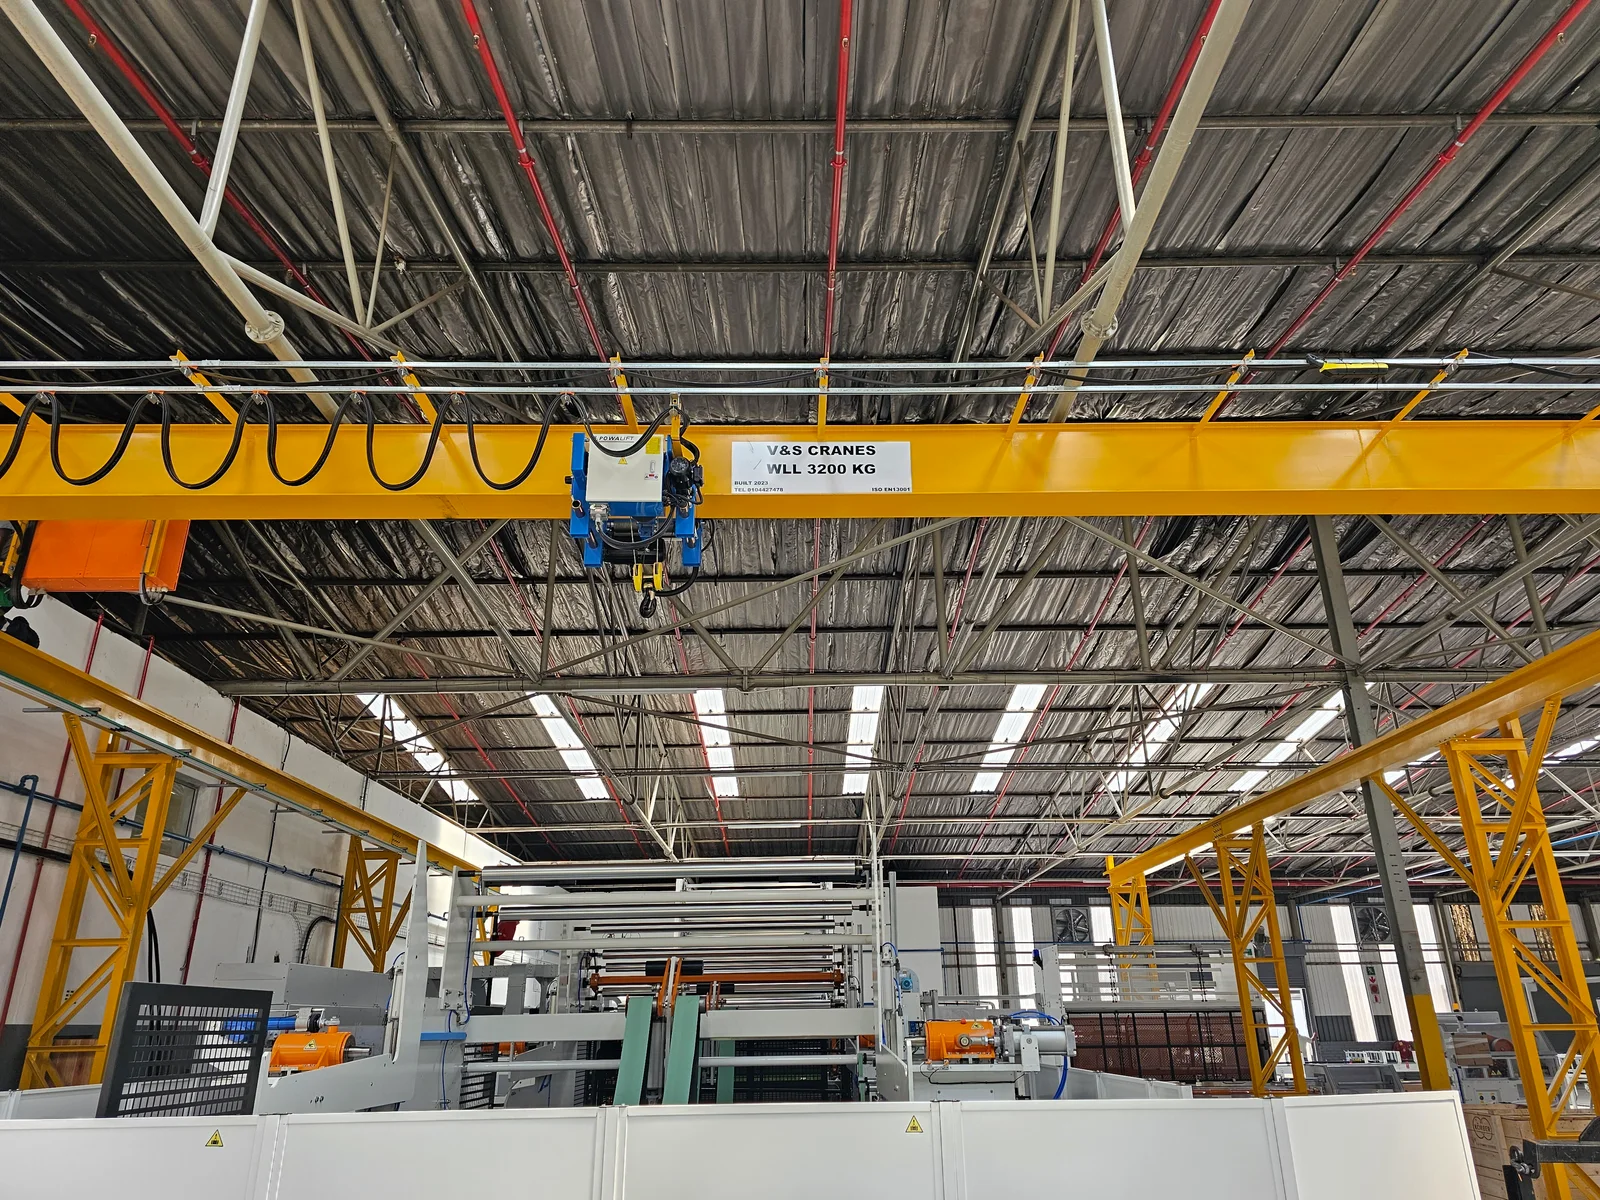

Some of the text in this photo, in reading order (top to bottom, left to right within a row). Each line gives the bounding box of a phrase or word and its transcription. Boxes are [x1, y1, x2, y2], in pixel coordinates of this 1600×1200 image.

[766, 445, 876, 456] V&S CRANES
[766, 463, 876, 475] WLL 3200 KG
